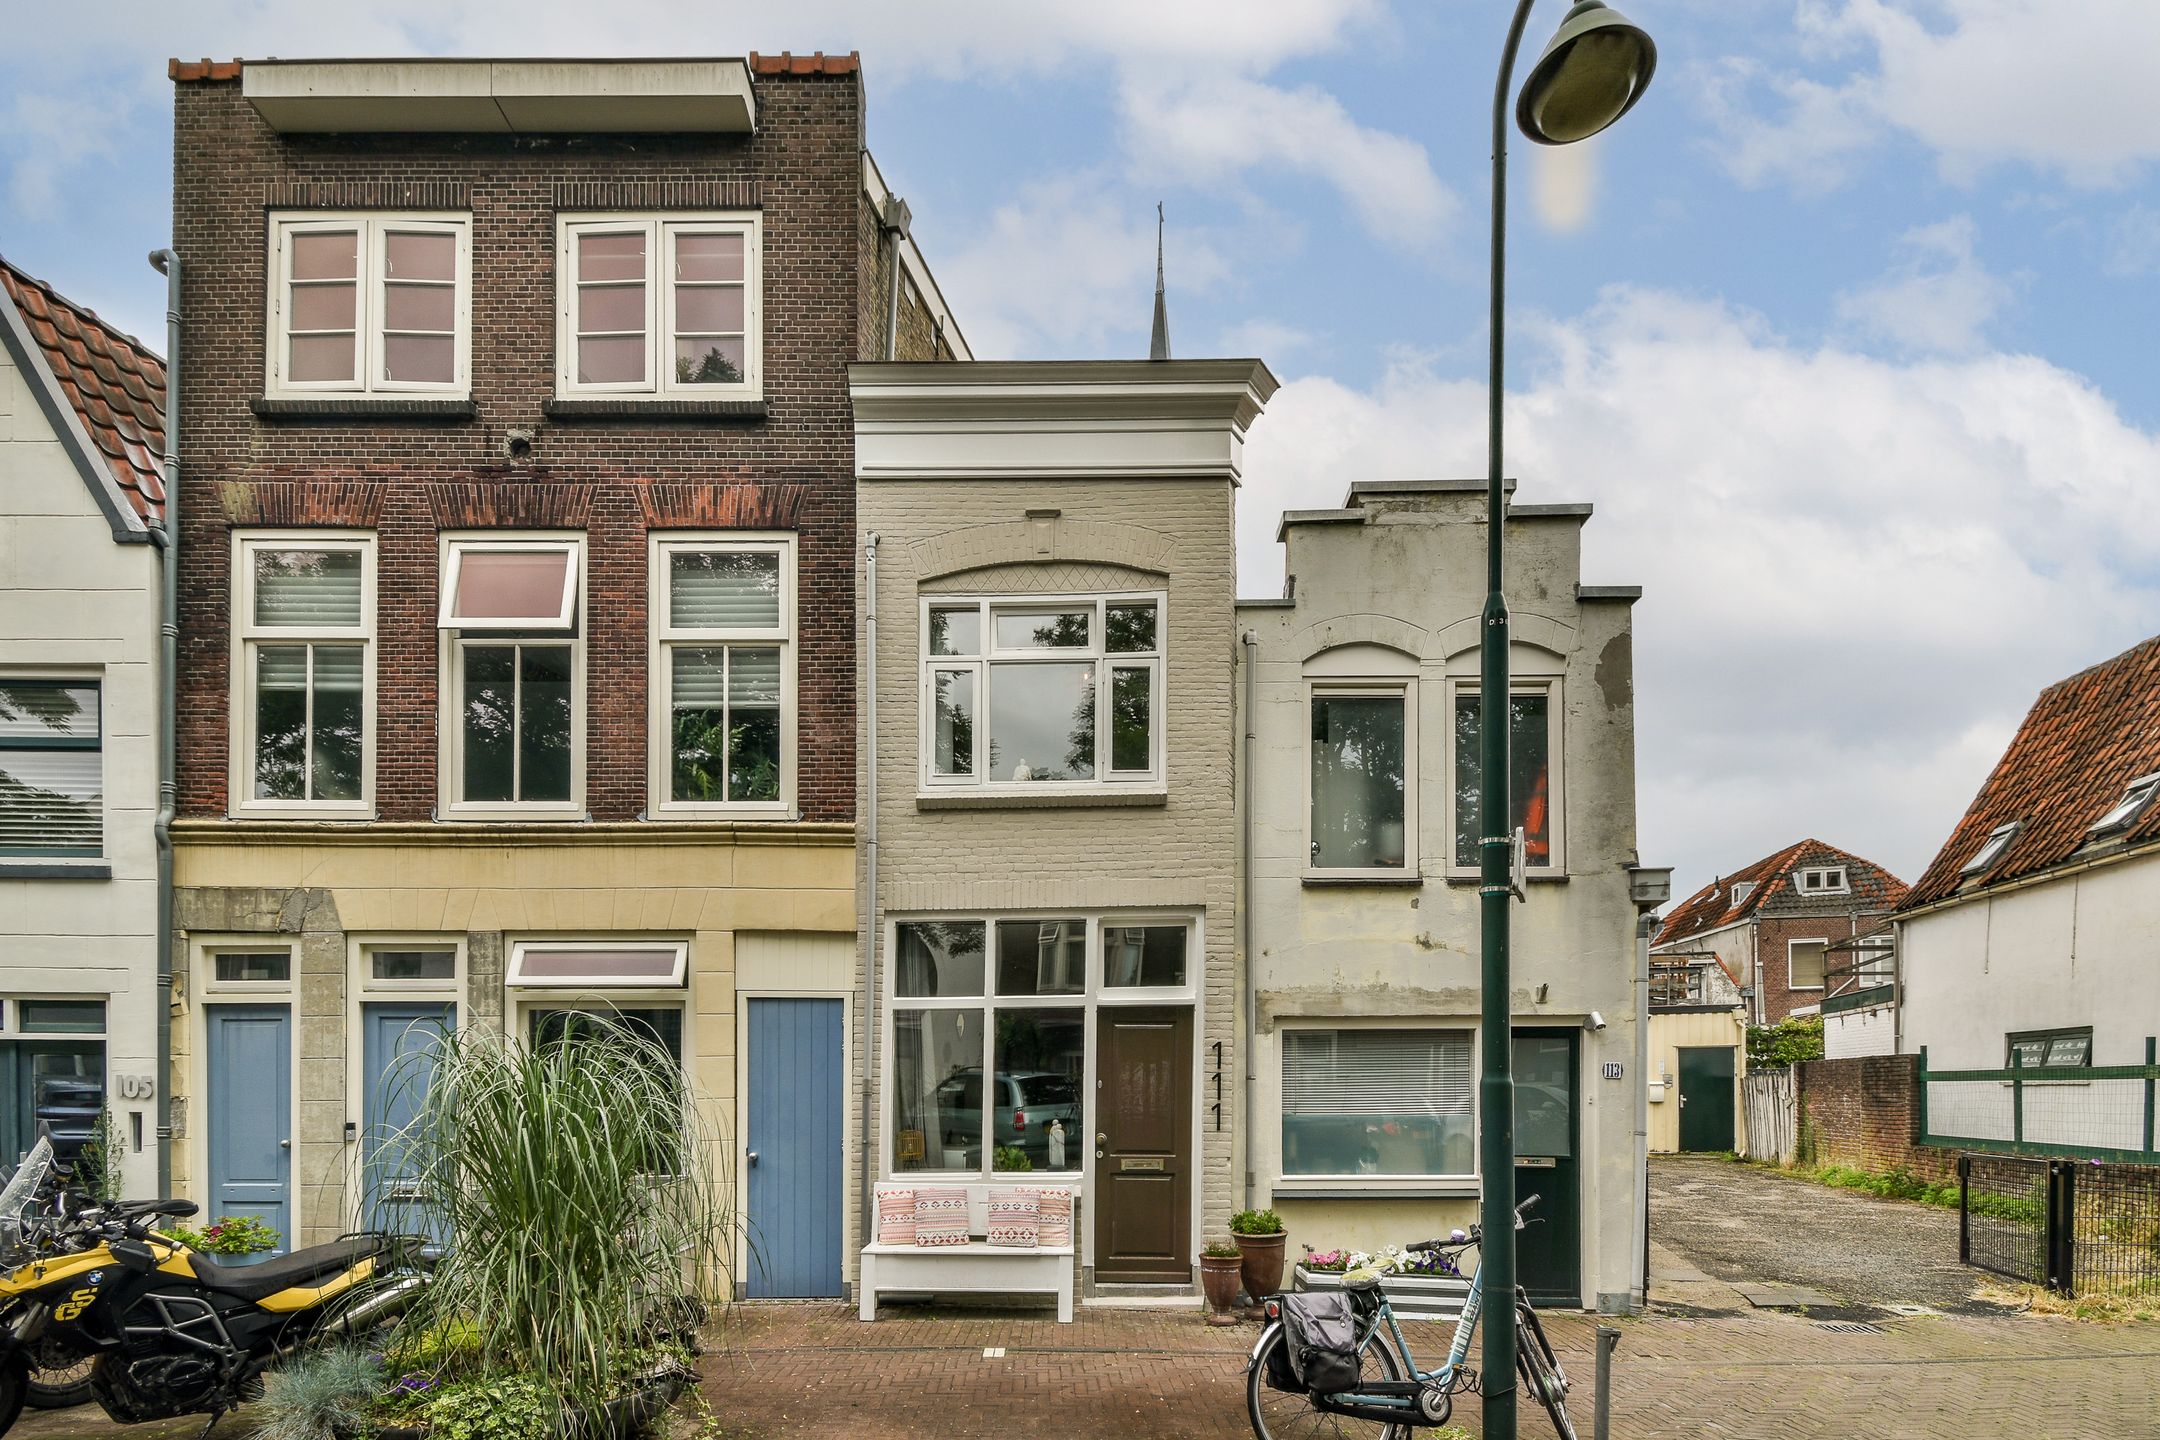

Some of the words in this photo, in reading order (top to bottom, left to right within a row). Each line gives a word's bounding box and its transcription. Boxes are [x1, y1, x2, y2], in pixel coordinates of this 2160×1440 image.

[1606, 1063, 1620, 1078] 113
[116, 1074, 153, 1098] 105
[1211, 1041, 1222, 1131] 111
[54, 1287, 98, 1321] GS
